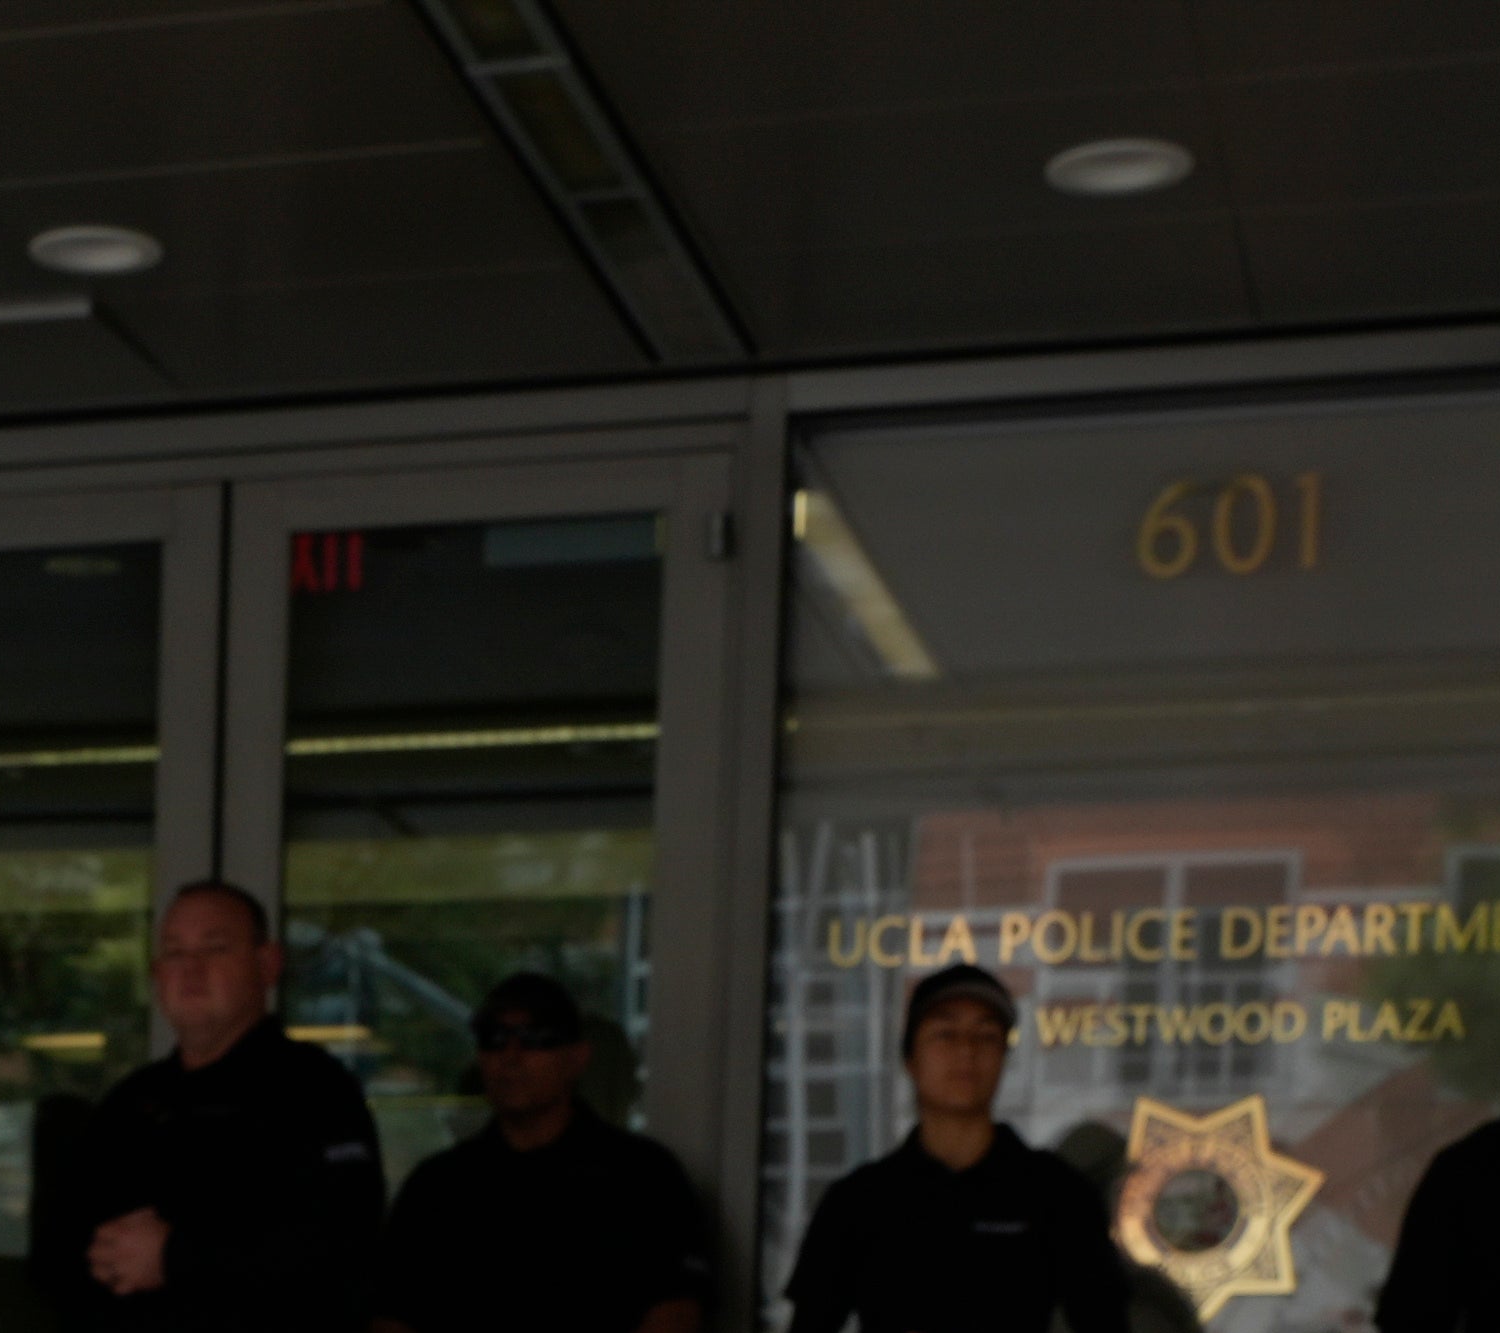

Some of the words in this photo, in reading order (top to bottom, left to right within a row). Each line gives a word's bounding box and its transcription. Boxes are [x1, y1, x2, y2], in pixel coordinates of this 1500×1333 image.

[1137, 471, 1321, 579] 601
[827, 913, 979, 969] UCLA
[1000, 908, 1200, 965] POLICE
[1034, 1001, 1309, 1047] WESTWOOD
[1321, 999, 1467, 1043] PLAZA
